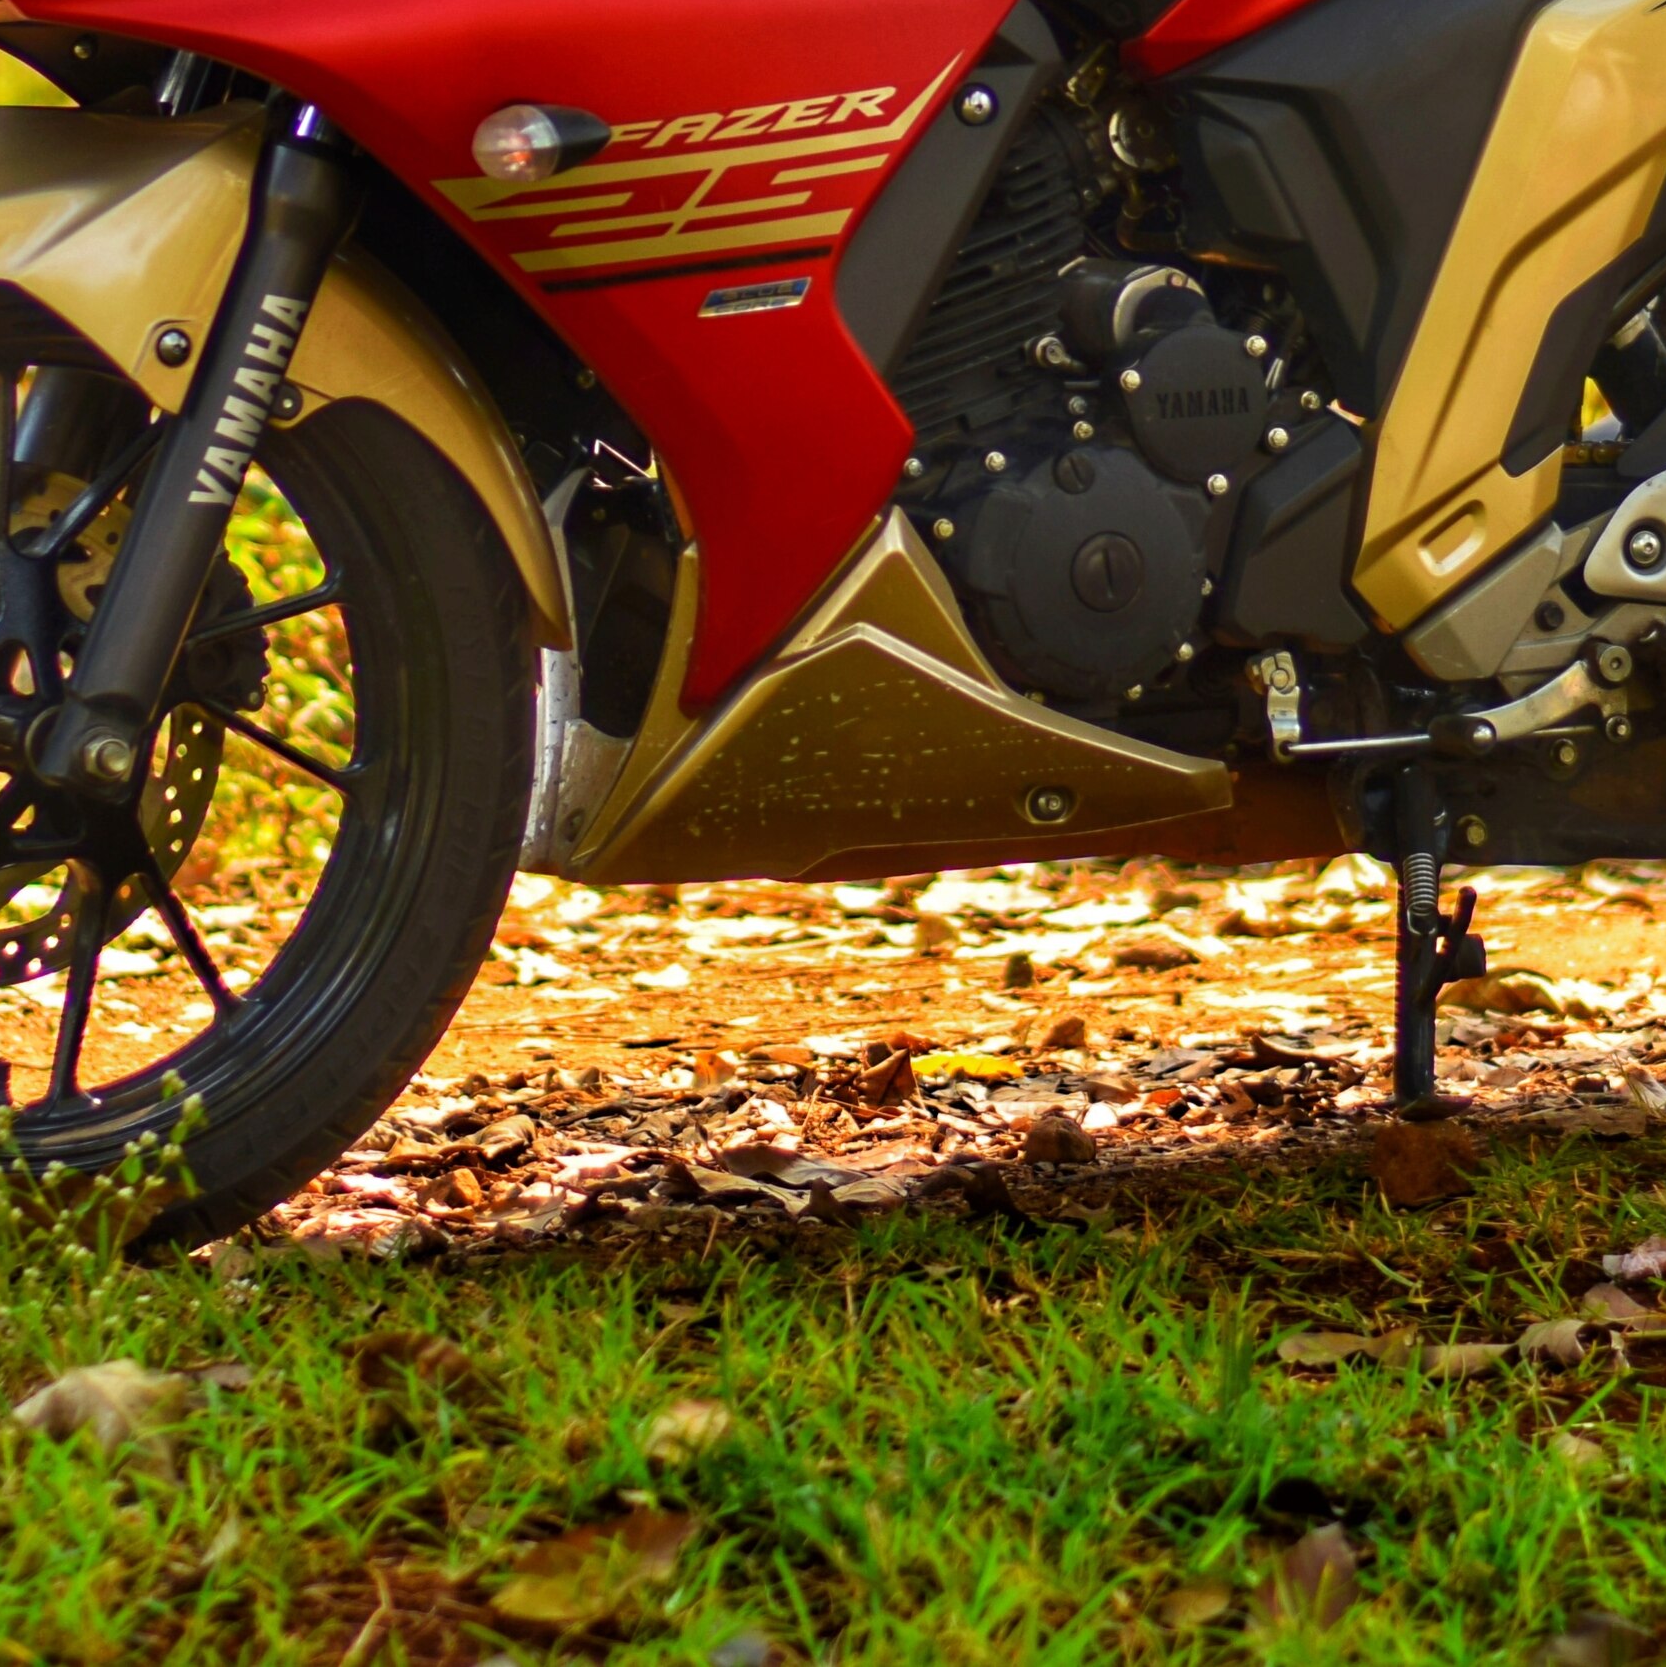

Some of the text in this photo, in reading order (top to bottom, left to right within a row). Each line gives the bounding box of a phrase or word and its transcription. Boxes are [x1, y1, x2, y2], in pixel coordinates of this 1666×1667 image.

[609, 85, 897, 149] FAZER
[187, 294, 309, 506] YAMAHA
[1156, 387, 1250, 419] YAMAHA
